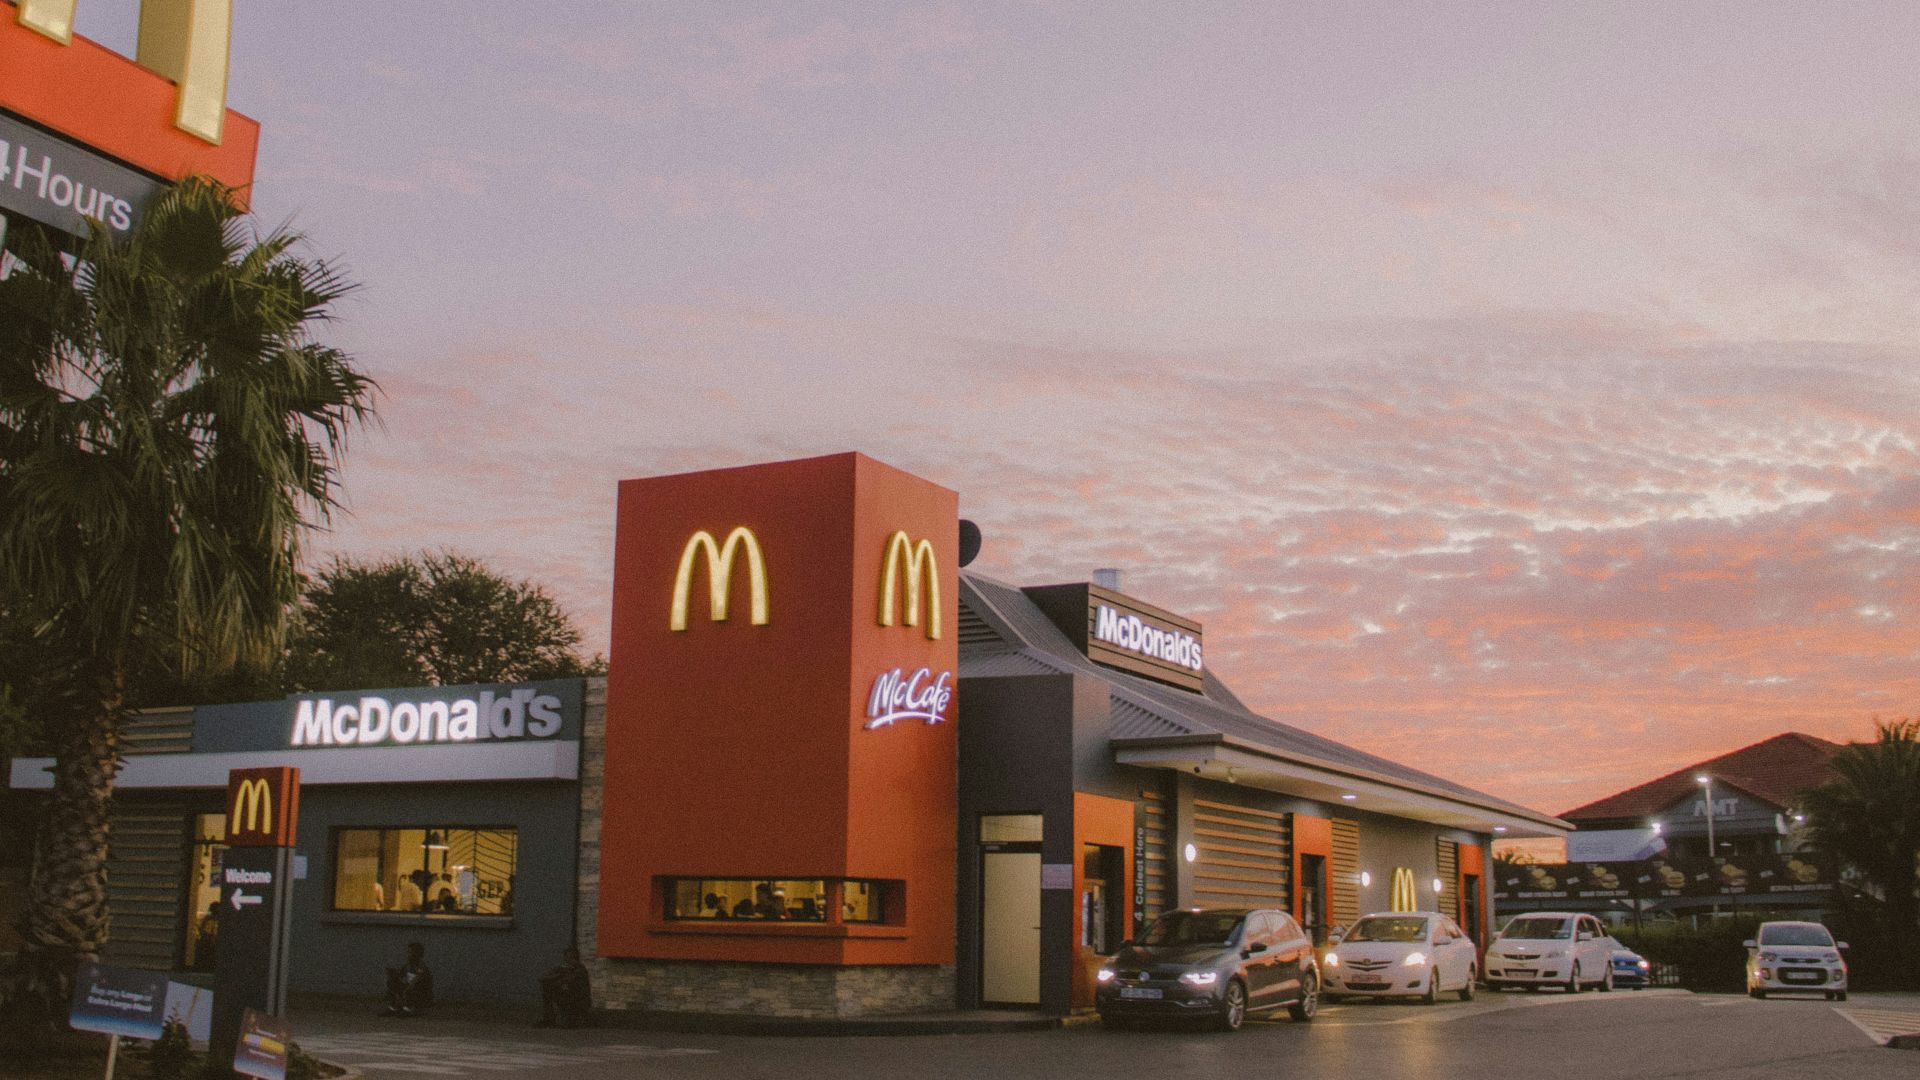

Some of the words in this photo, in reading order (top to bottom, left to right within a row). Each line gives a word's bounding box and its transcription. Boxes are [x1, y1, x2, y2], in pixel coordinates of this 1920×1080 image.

[1095, 604, 1202, 671] McDonald's
[290, 688, 562, 746] McDonald's
[867, 667, 951, 725] McCafé
[1135, 827, 1145, 857] Here
[225, 868, 272, 884] Welcome
[1135, 859, 1145, 904] Collect
